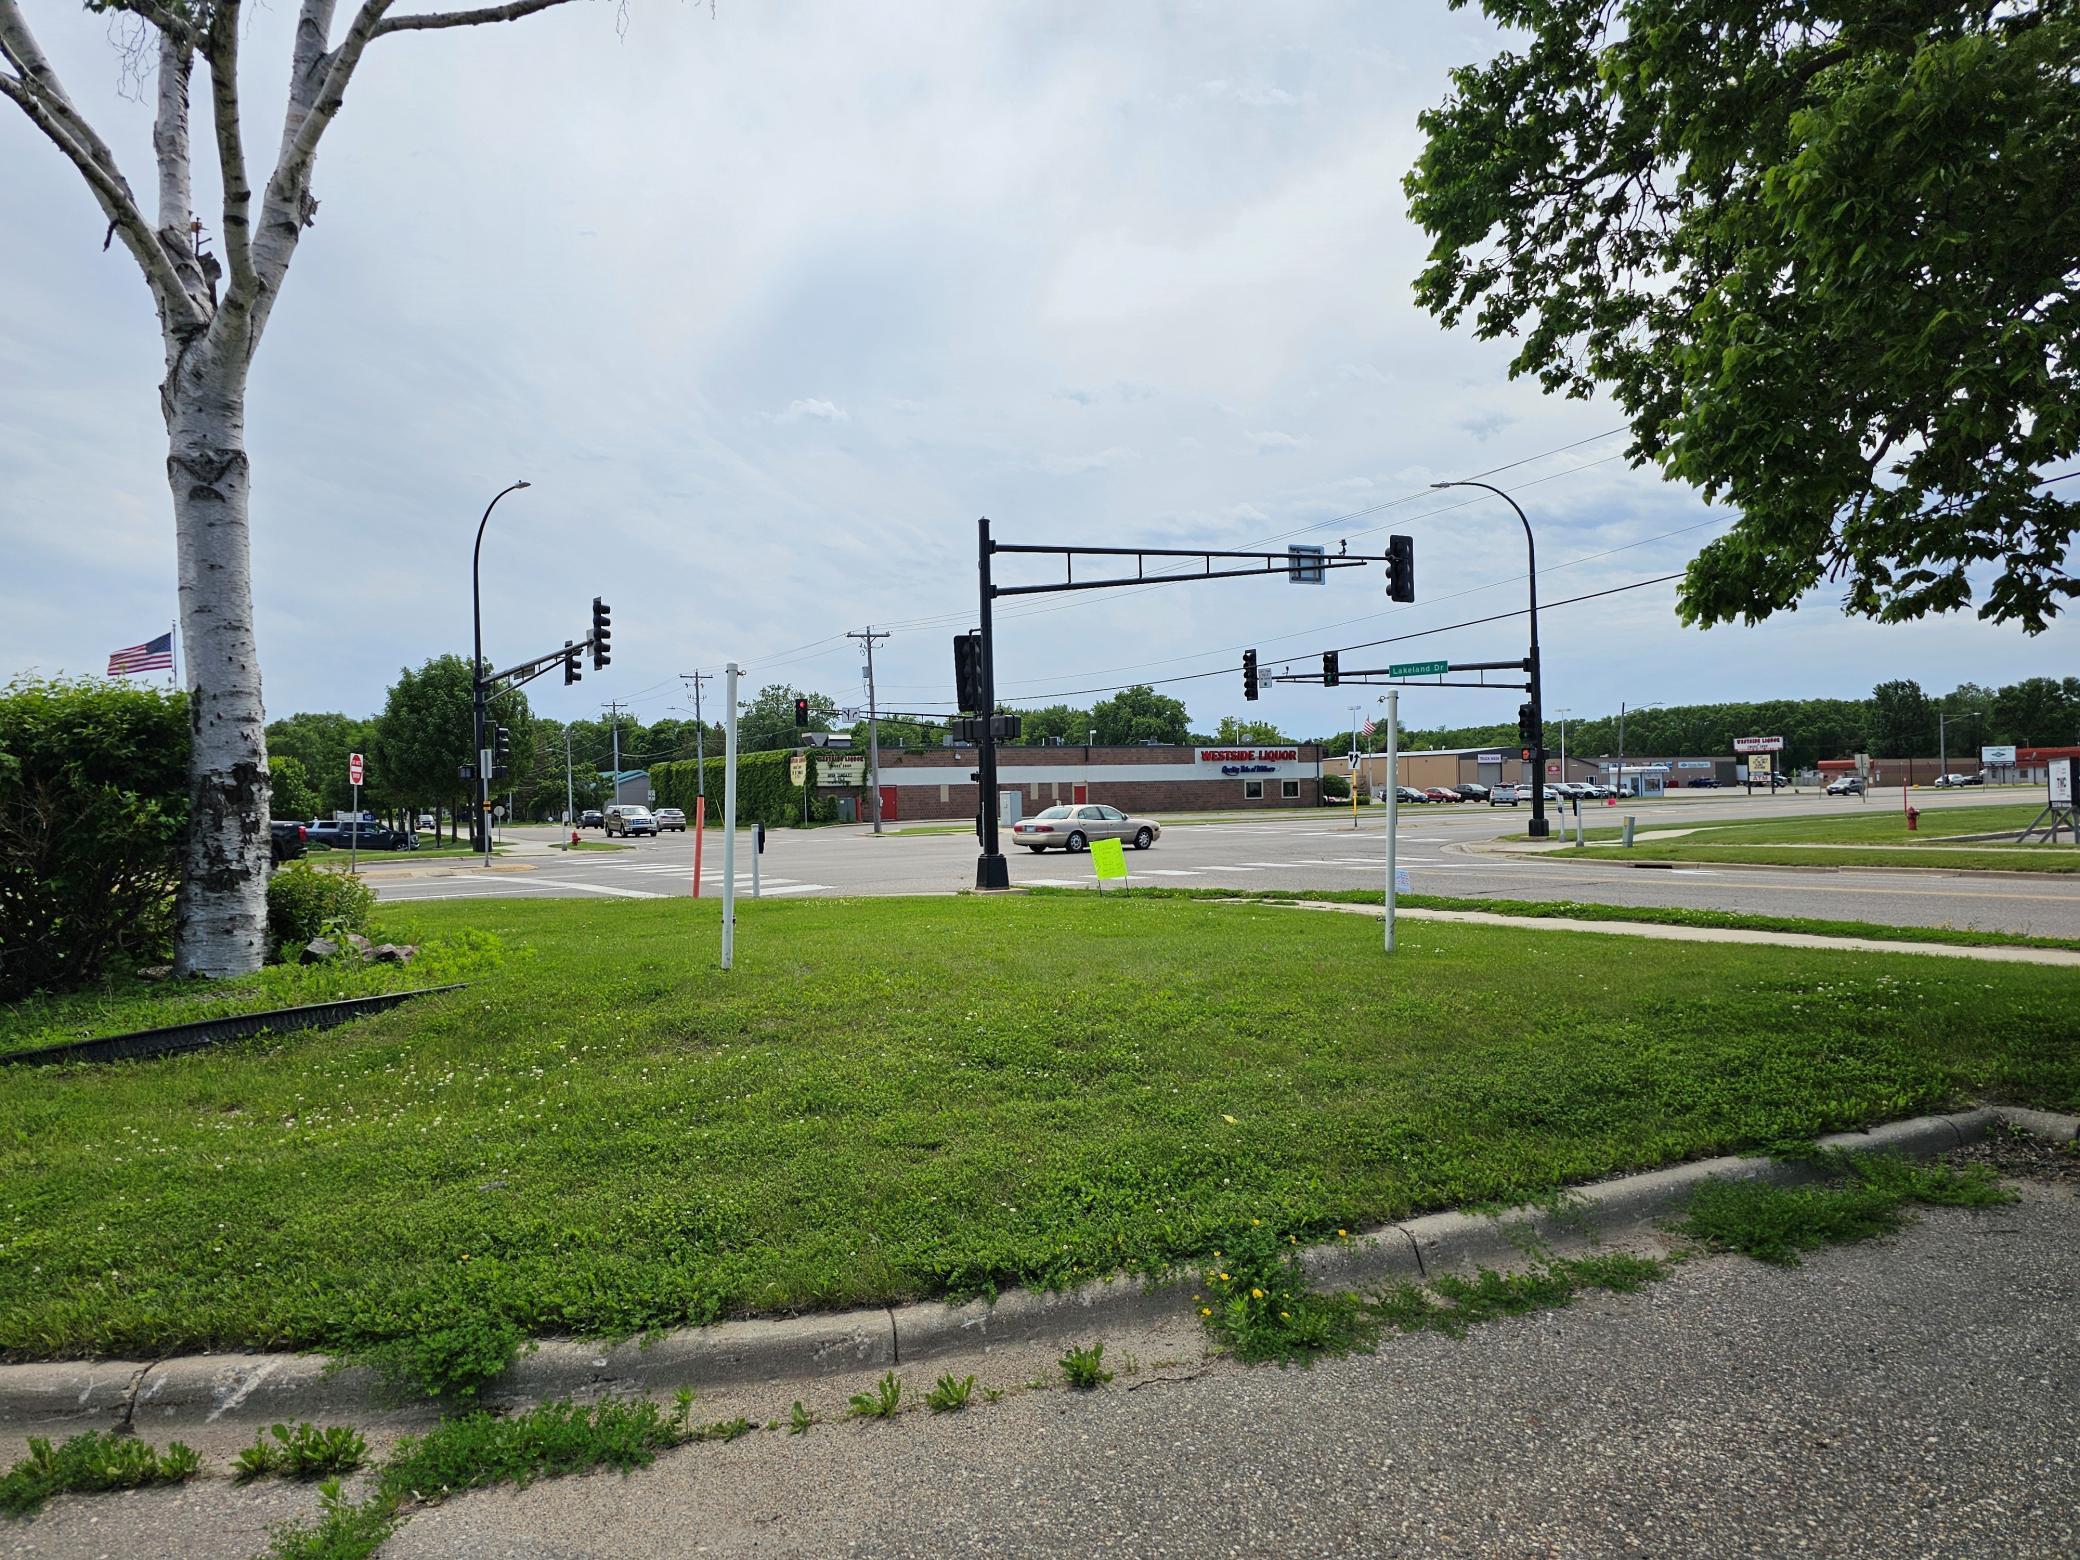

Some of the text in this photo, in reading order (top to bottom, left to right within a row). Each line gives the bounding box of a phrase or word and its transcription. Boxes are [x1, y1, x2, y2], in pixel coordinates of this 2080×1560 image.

[1392, 665, 1431, 675] Lakeland
[1201, 750, 1297, 762] WESTSIDE LIQUOR
